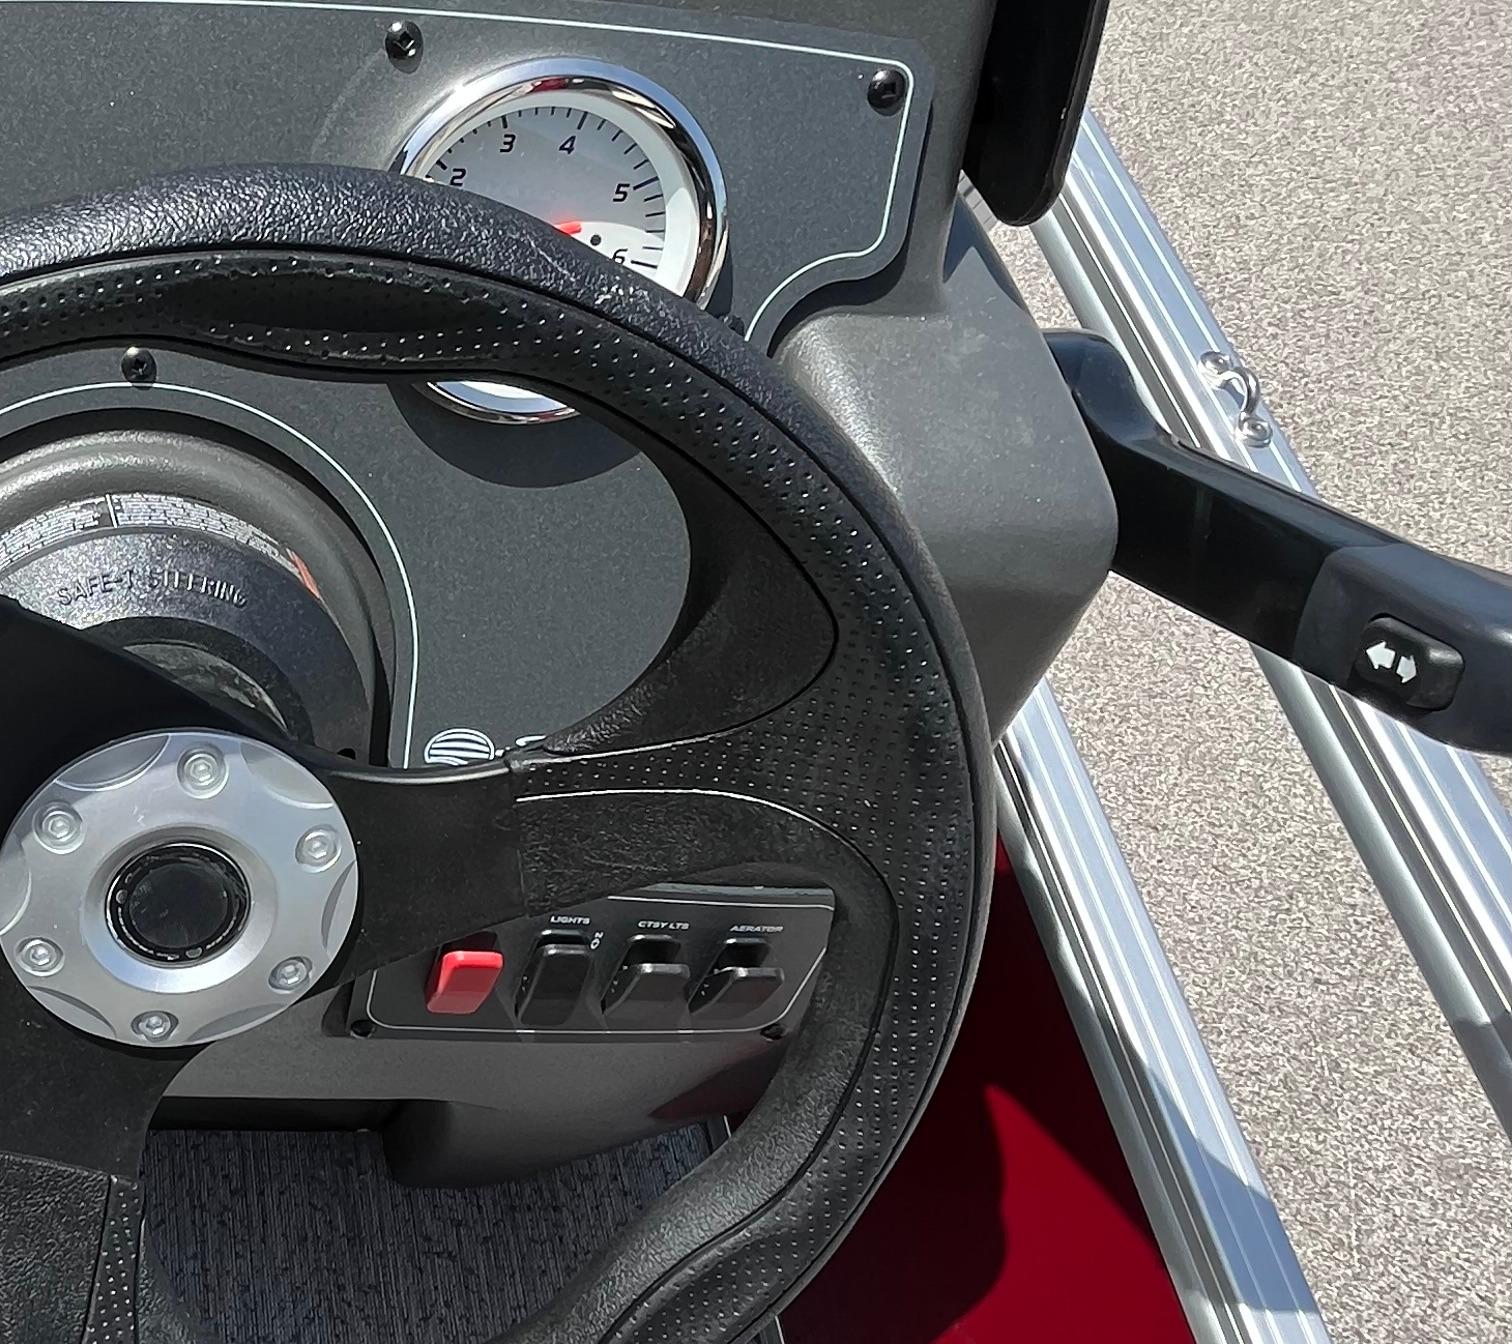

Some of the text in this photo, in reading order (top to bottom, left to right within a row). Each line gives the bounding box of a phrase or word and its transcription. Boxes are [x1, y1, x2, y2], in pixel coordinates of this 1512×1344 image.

[499, 133, 516, 153] 3
[558, 135, 576, 154] 4
[449, 168, 466, 186] 2
[612, 183, 630, 203] 5
[612, 248, 628, 265] 6
[550, 915, 590, 925] LIGHTS
